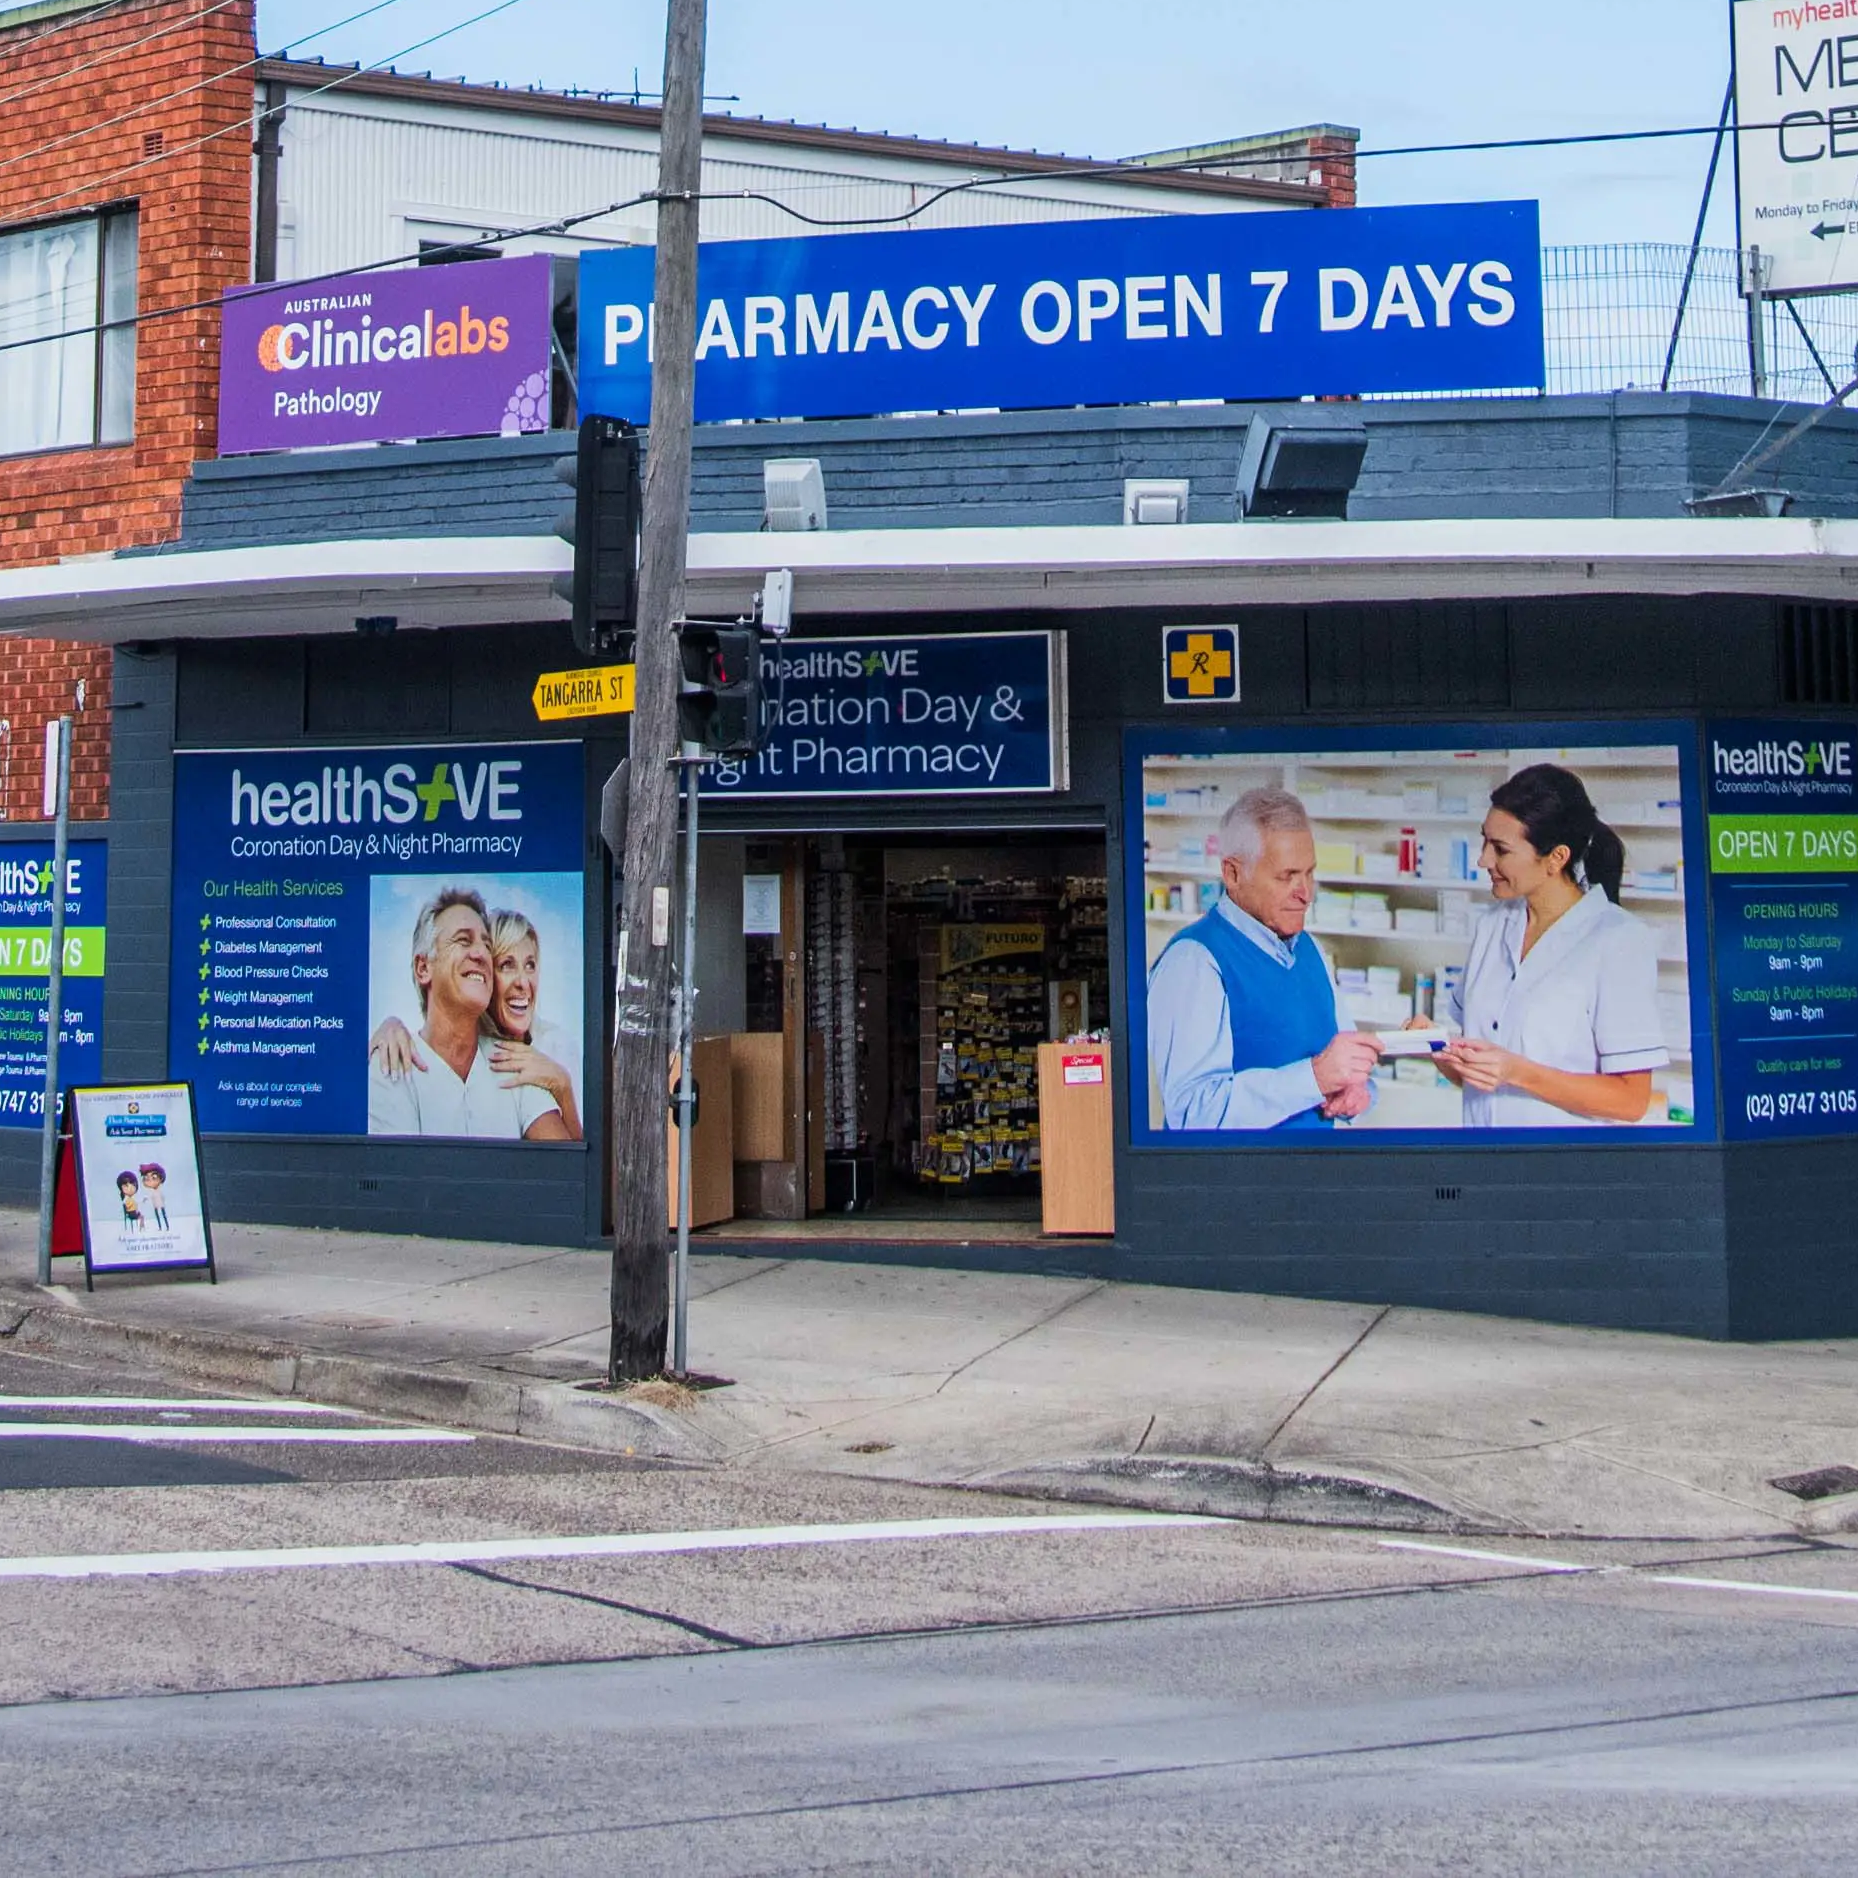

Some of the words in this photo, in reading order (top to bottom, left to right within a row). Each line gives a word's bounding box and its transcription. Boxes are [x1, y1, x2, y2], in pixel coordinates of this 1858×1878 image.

[1755, 205, 1804, 221] Monday
[1806, 202, 1820, 215] to
[284, 293, 372, 315] AUSTRALIAN
[1021, 273, 1222, 345] OPEN
[1249, 270, 1290, 333] 7
[1318, 260, 1516, 332] DAYS
[274, 386, 382, 417] Pathology
[540, 679, 604, 709] TANGARRA
[609, 675, 624, 700] ST
[760, 688, 890, 727] nation
[901, 687, 982, 733] Day
[989, 685, 1024, 722] &
[793, 737, 1005, 782] Pharmacy
[1715, 780, 1764, 794] Coronation
[1764, 780, 1780, 796] Day
[1781, 780, 1790, 793] &
[1790, 781, 1811, 797] Night
[1811, 780, 1853, 796] Pharmacy
[231, 835, 327, 857] Coronation
[330, 834, 363, 860] Day
[365, 834, 380, 854] &
[383, 832, 429, 860] Night
[432, 832, 523, 858] Pharmacy
[1718, 829, 1778, 859] OPEN
[1783, 831, 1796, 858] 7
[1802, 829, 1857, 858] DAYS
[203, 880, 229, 898] Our
[233, 879, 278, 897] Health
[282, 878, 343, 896] Services
[3, 899, 17, 915] Day
[43, 899, 81, 915] Phmacy
[1744, 904, 1796, 920] OPENING
[1798, 903, 1839, 919] HOURS
[215, 916, 273, 929] Professional
[276, 916, 336, 929] Consultation
[16, 937, 27, 966] 7
[215, 940, 257, 954] Diabetes
[259, 940, 322, 957] Management
[1744, 935, 1783, 952] Monday
[1786, 935, 1797, 948] to
[1798, 933, 1842, 951] Saturday
[214, 965, 243, 978] Blood
[245, 966, 290, 978] Pressure
[291, 965, 329, 979] Checks
[1768, 954, 1792, 971] 9am
[1800, 954, 1823, 972] 9pm
[214, 990, 248, 1006] Weight
[250, 990, 313, 1006] Management
[1732, 987, 1771, 1005] Sunday
[1783, 985, 1814, 1001] Public
[1815, 985, 1858, 1002] Holidays
[0, 1007, 34, 1024] Saturday
[38, 1008, 50, 1023] 9a
[64, 1008, 83, 1025] 9pm
[213, 1015, 255, 1028] Personal
[257, 1015, 311, 1029] Medication
[313, 1016, 344, 1029] Packs
[1769, 1005, 1793, 1022] 9am
[1801, 1005, 1824, 1022] 8pm
[9, 1026, 43, 1044] Holidays
[75, 1029, 95, 1046] 8pm
[212, 1040, 250, 1054] Asthma
[252, 1041, 316, 1057] Management
[1756, 1058, 1787, 1074] Quality
[218, 1080, 233, 1091] Ask
[234, 1082, 244, 1091] us
[246, 1081, 269, 1091] about
[285, 1082, 322, 1094] complete
[29, 1092, 64, 1115] 315
[237, 1098, 259, 1109] range
[260, 1096, 269, 1106] of
[270, 1097, 302, 1107] services
[1746, 1093, 1775, 1122] (02)
[1778, 1091, 1815, 1116] 9747
[1820, 1089, 1857, 1113] 3105
